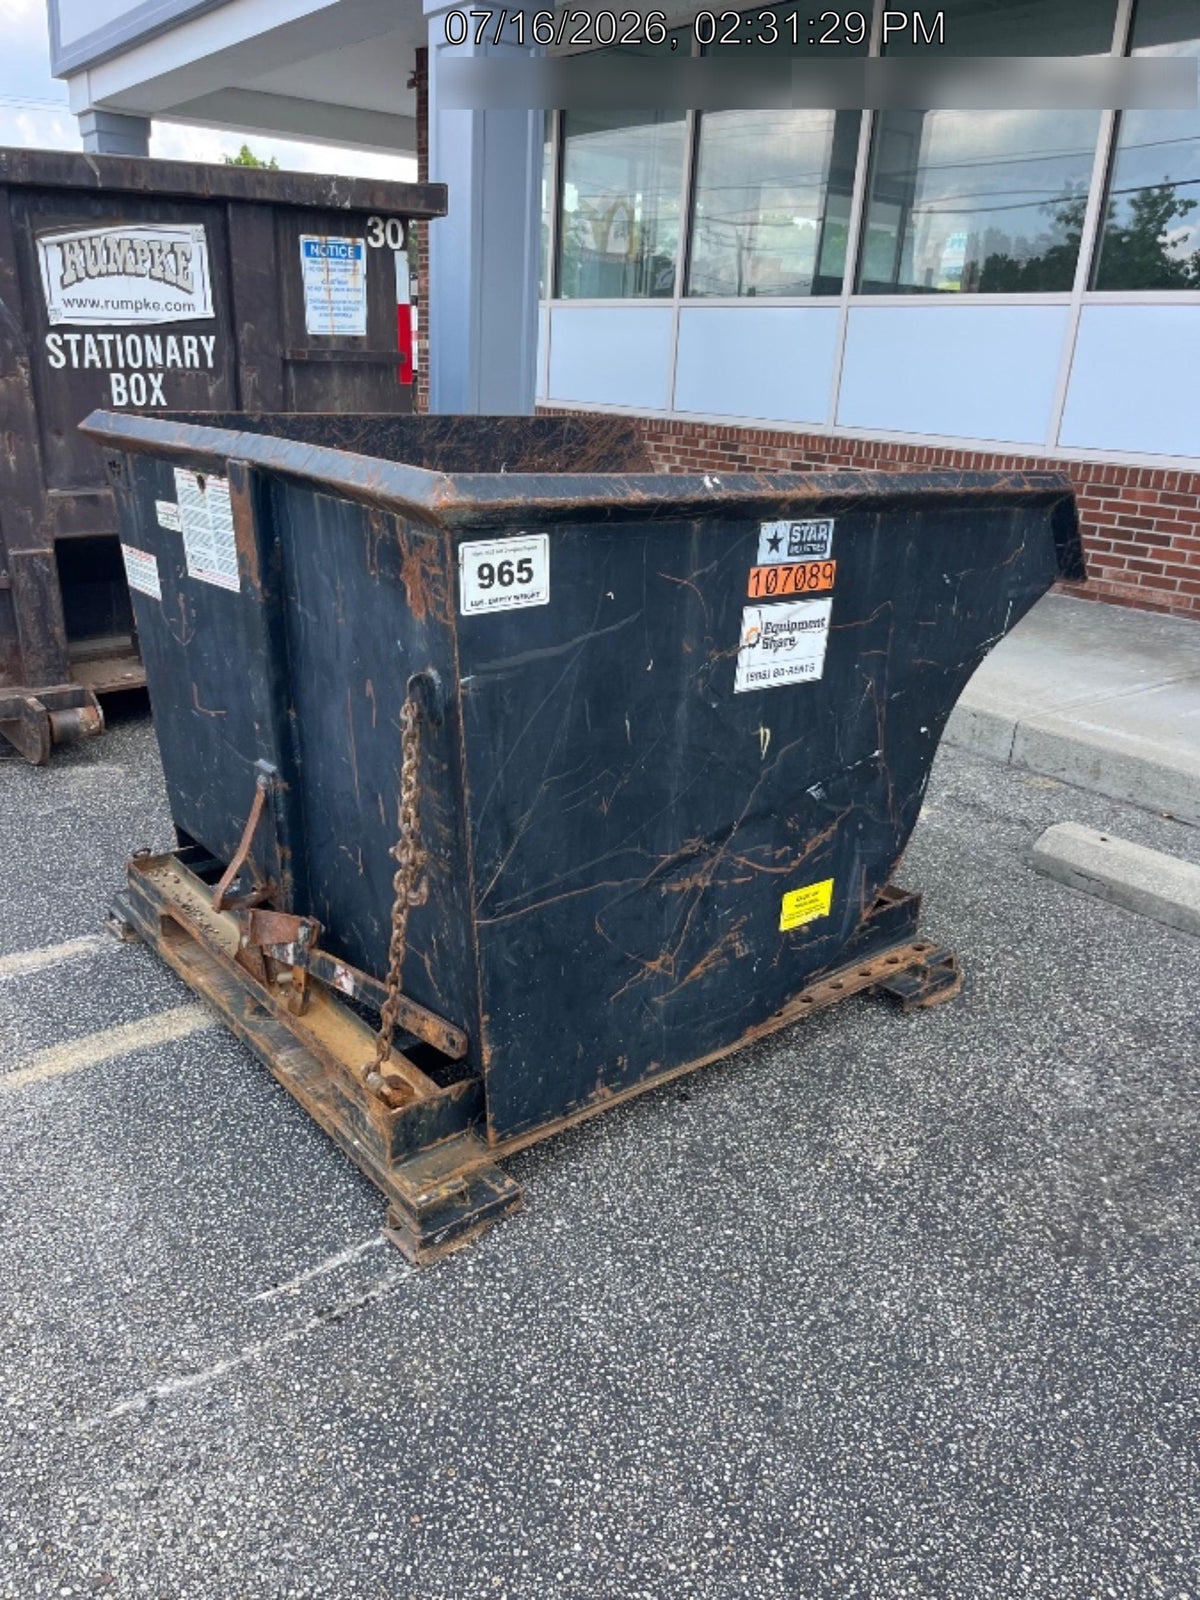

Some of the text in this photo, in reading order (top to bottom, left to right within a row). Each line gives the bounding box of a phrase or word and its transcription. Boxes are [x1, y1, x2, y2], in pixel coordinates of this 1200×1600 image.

[366, 216, 405, 250] 30
[59, 236, 195, 295] RUMPKE
[310, 244, 356, 259] NOTICE
[62, 297, 197, 314] www.rumpke.com
[45, 333, 216, 369] STATIONARY
[110, 373, 168, 407] BOX
[791, 524, 828, 543] STAR
[477, 557, 534, 589] 965
[751, 562, 834, 597] 107089
[763, 617, 826, 637] Equipment
[762, 635, 796, 654] Share
